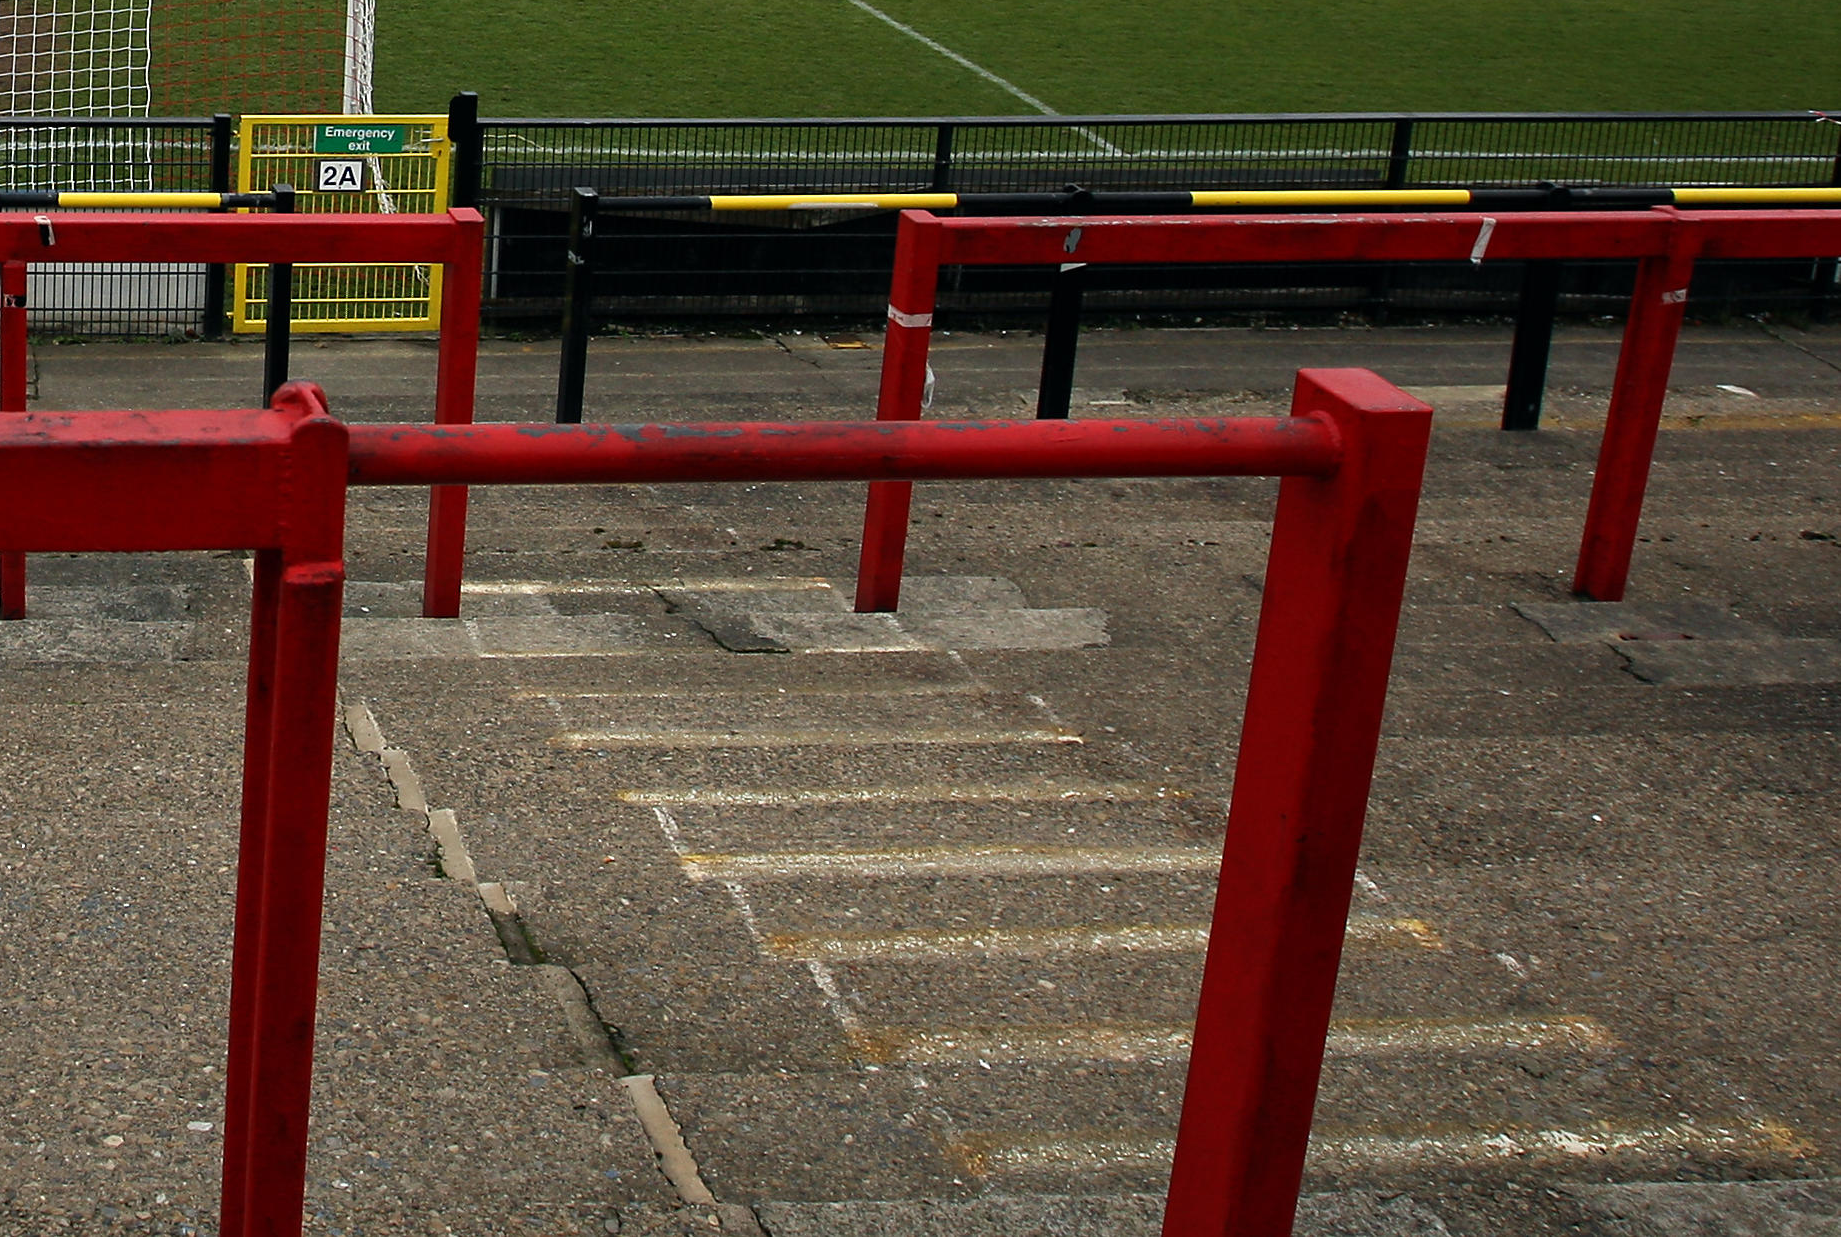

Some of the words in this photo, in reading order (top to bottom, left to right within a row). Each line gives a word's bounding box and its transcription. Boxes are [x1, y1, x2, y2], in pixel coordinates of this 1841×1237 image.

[325, 126, 395, 141] Emergency
[348, 141, 370, 152] exit
[324, 167, 358, 186] 2A
